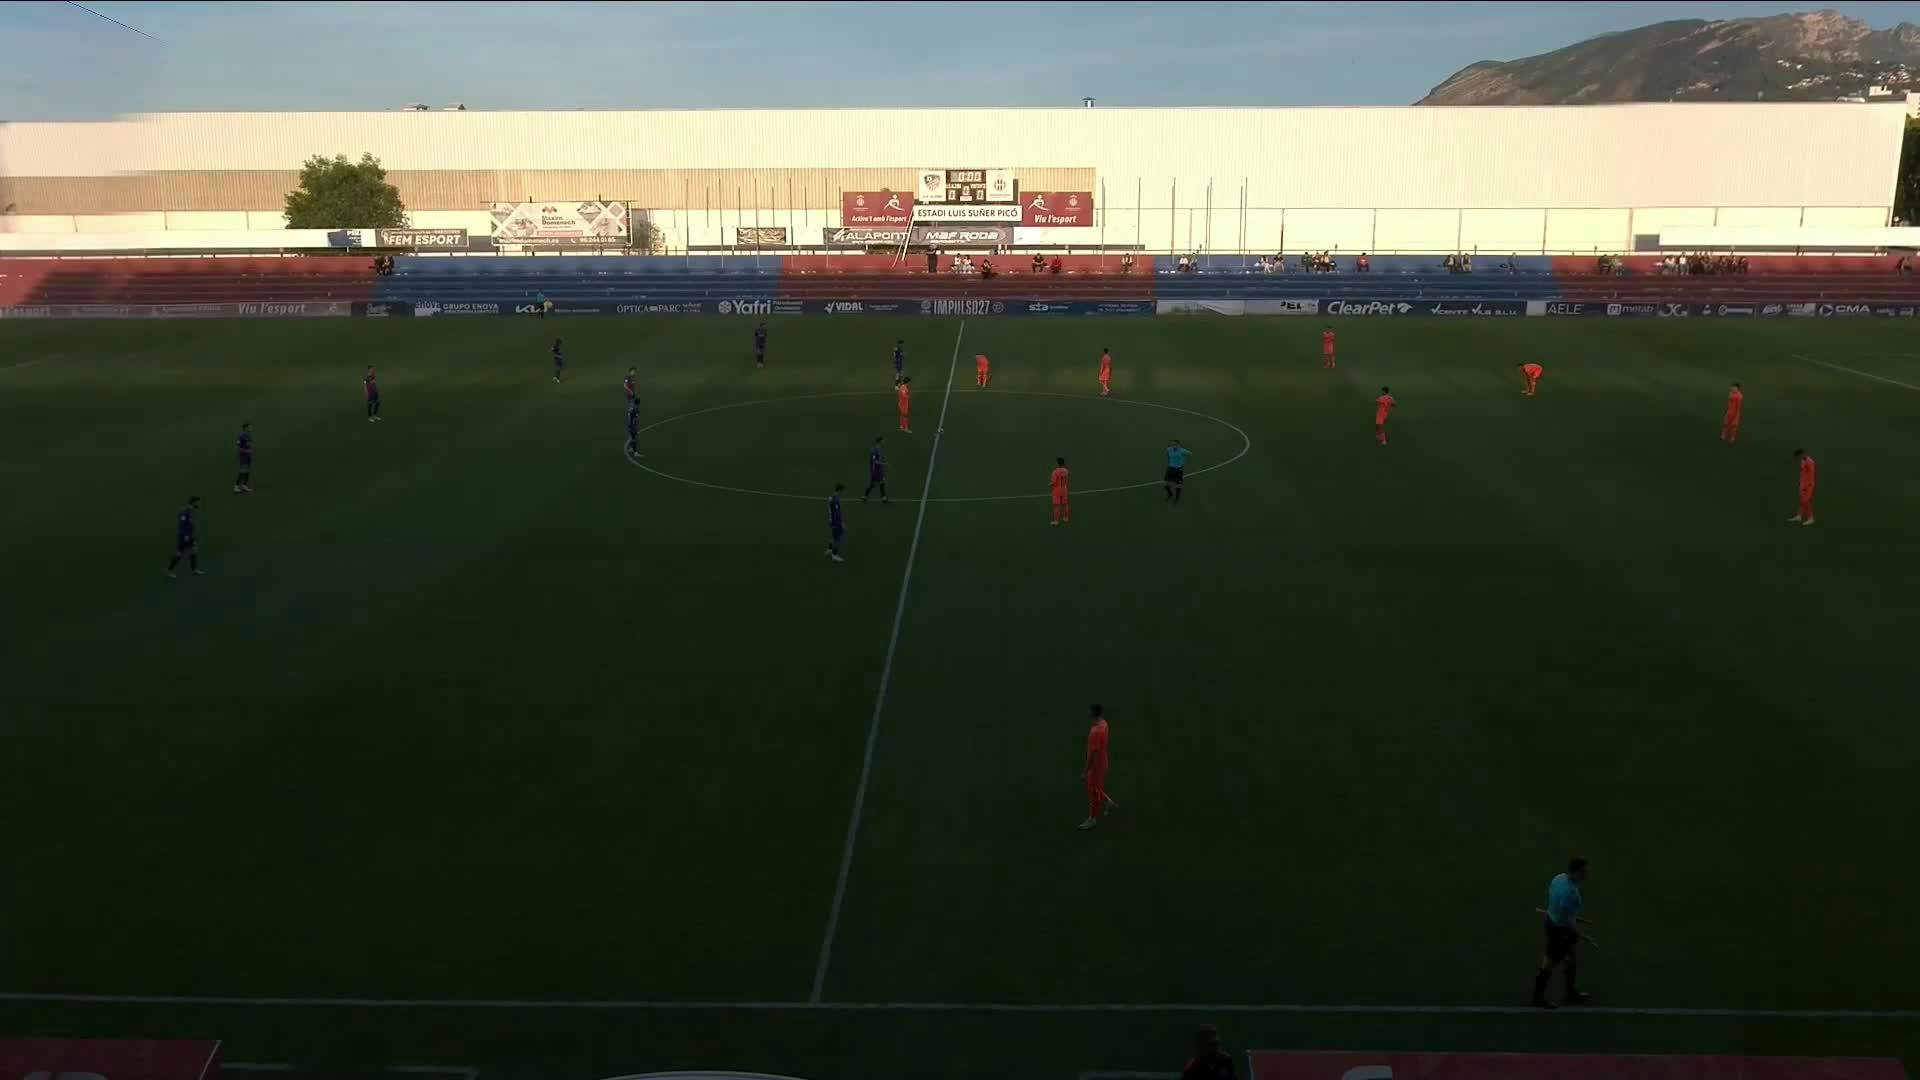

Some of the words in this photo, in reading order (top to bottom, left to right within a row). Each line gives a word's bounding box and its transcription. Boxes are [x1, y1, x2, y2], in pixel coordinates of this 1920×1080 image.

[918, 209, 946, 217] ESTADI
[948, 209, 966, 217] LUIS
[968, 208, 995, 217] SUÑER
[998, 208, 1018, 217] PICÓ
[886, 215, 907, 223] l'esport
[1034, 215, 1047, 223] Viu
[1048, 214, 1076, 224] l'esport
[388, 235, 412, 245] FEM
[415, 235, 461, 245] ESPORT
[846, 232, 908, 240] ALAPONT
[239, 303, 257, 314] Viu
[261, 303, 306, 315] l'esport
[443, 303, 471, 311] GRUPO
[472, 303, 499, 311] ENOVA
[658, 304, 682, 313] PARC
[732, 300, 772, 315] Yafri
[836, 302, 864, 311] VIDAL
[934, 300, 990, 315] IMPULSO27
[1327, 301, 1396, 315] ClearPet
[1835, 304, 1871, 313] CMA
